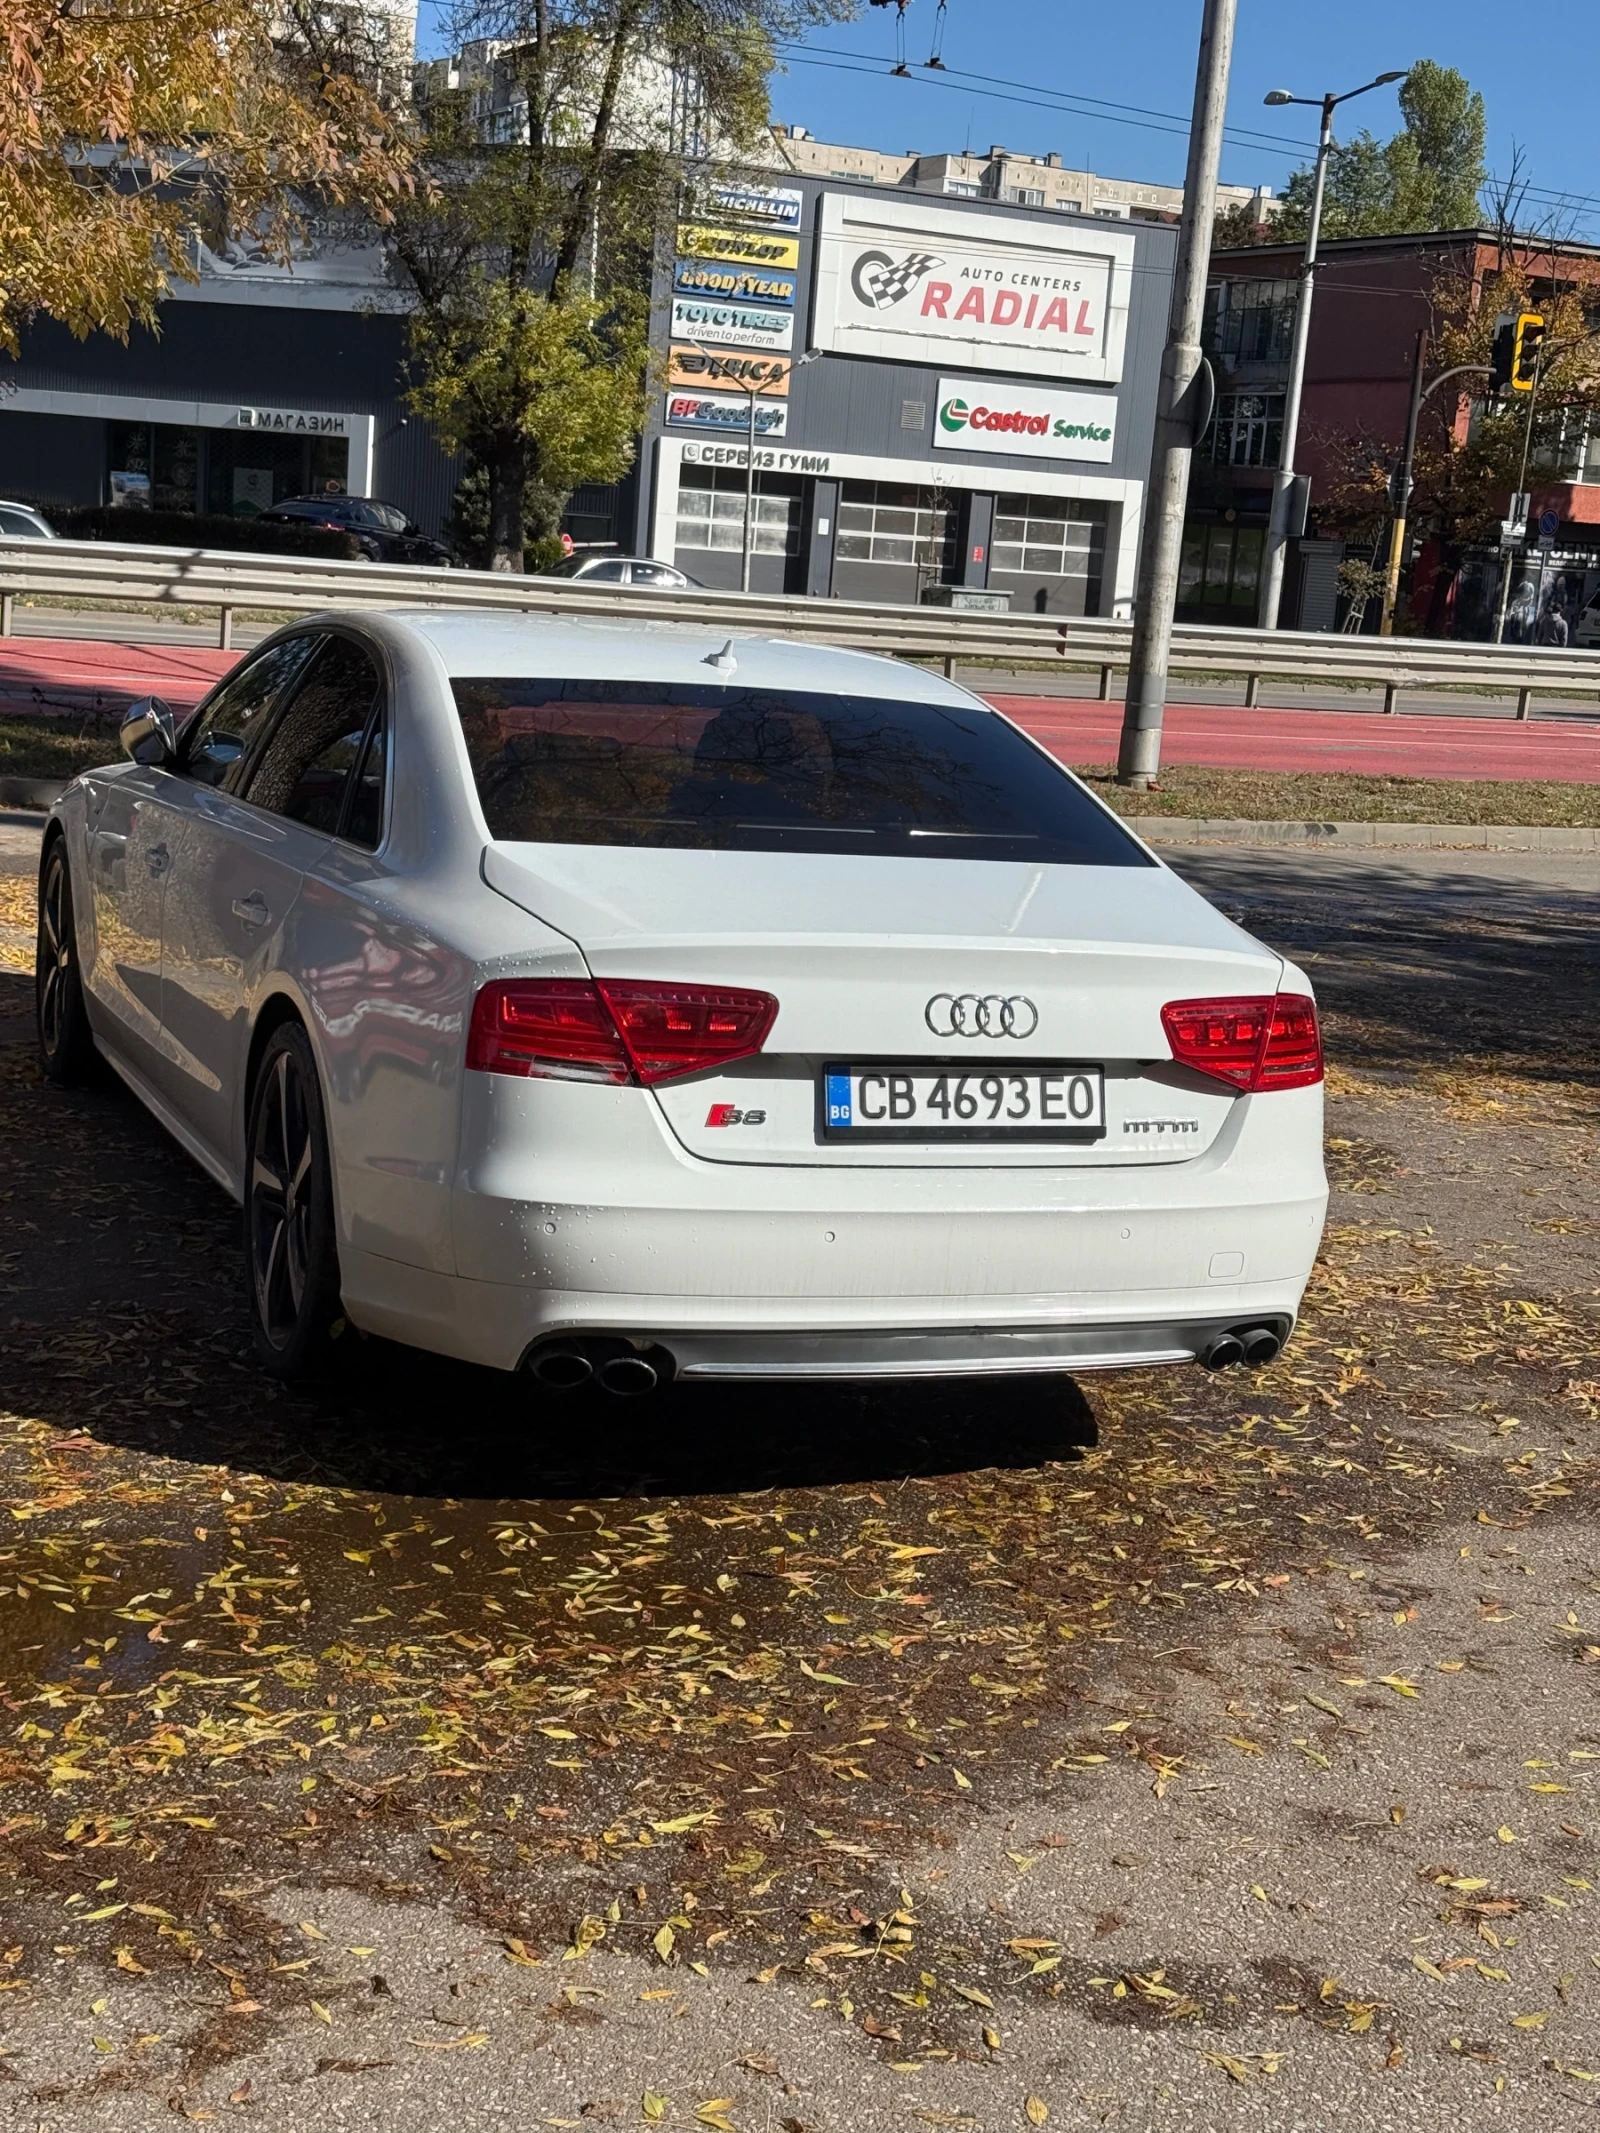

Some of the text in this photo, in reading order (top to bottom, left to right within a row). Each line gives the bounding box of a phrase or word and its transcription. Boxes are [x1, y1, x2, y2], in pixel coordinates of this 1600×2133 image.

[716, 195, 798, 218] MICHELIN
[960, 266, 1082, 292] AUTO CENTERS
[676, 303, 791, 333] TOYO TIRES
[920, 281, 1095, 336] RADIAL
[687, 325, 775, 346] driven to perform
[258, 412, 345, 433] МАГАЗИН
[970, 406, 1112, 442] Castrol Service
[702, 446, 830, 473] СЕРВИЗ ГУМИ
[859, 1074, 917, 1120] CB
[927, 1074, 1031, 1120] 4693
[831, 1105, 850, 1119] BG
